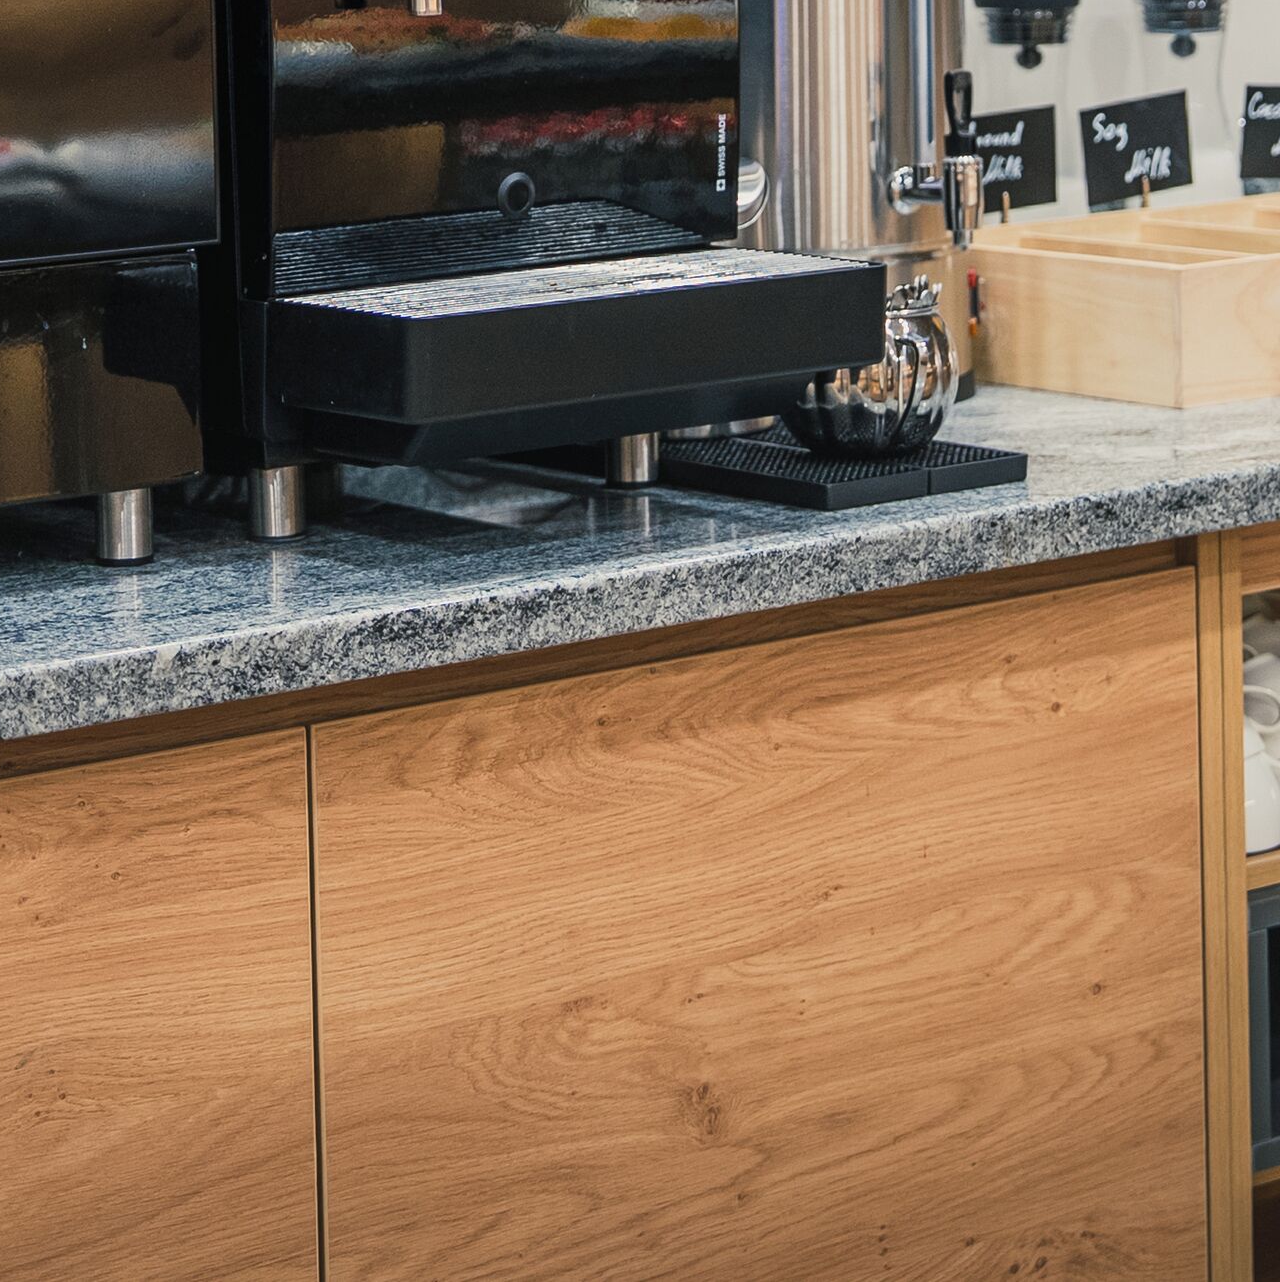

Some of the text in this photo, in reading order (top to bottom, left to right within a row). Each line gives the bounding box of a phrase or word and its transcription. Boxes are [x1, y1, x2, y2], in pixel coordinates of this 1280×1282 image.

[717, 113, 727, 177] SWISS MADE
[1092, 112, 1129, 152] Soy
[1124, 146, 1171, 183] Milk
